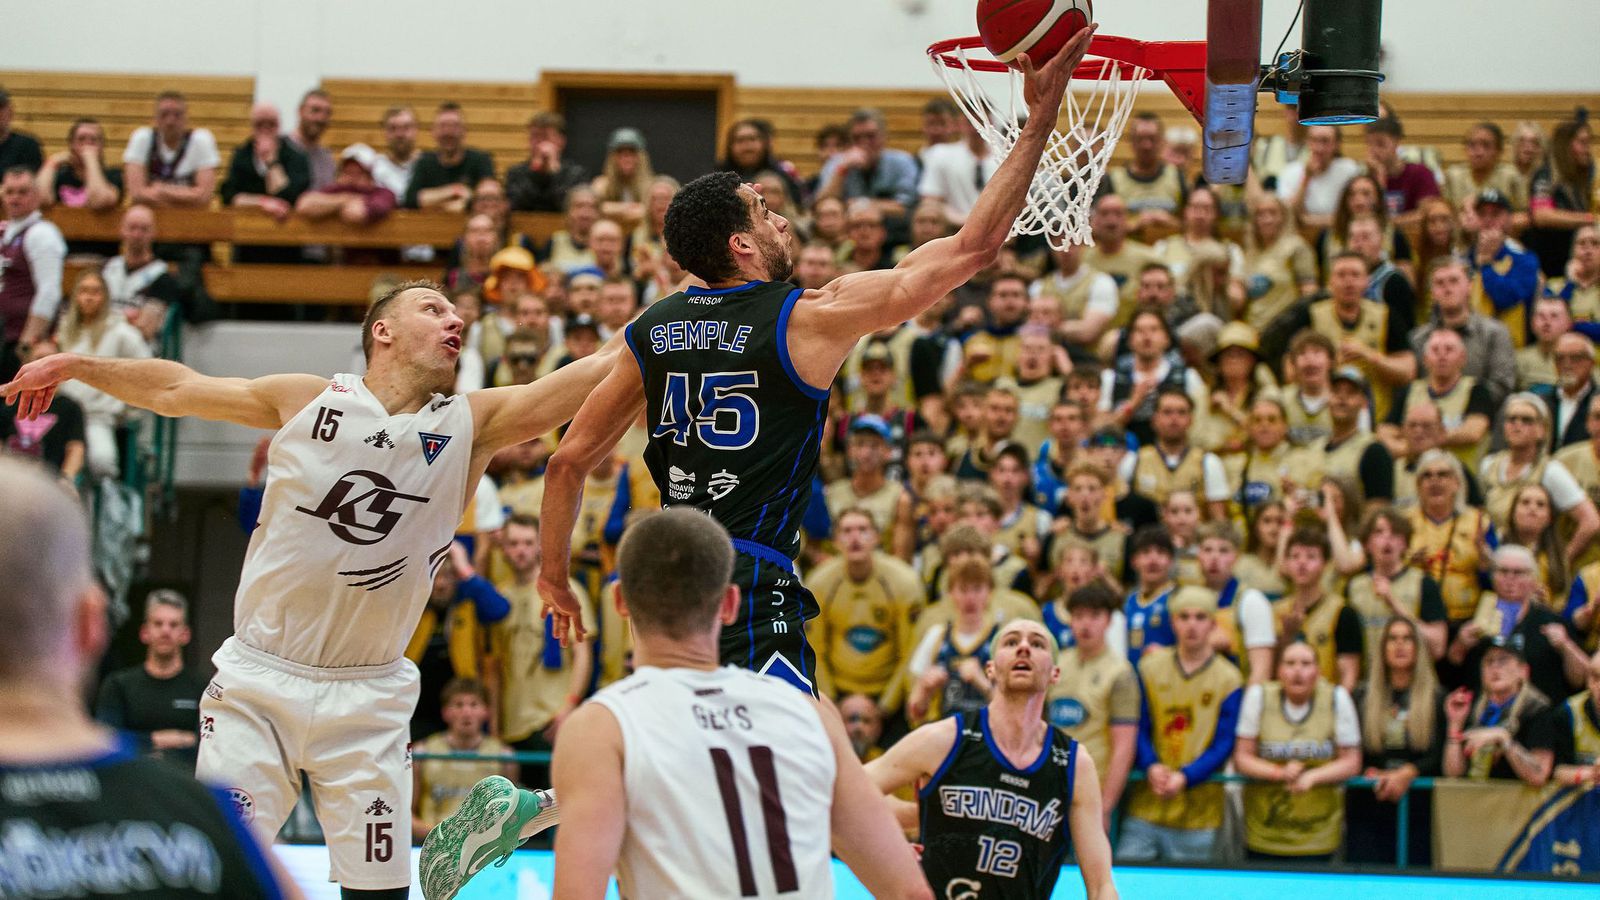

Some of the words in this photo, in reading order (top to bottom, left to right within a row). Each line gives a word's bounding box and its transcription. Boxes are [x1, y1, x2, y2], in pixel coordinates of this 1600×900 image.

[688, 296, 724, 306] HENSON
[650, 320, 753, 354] SEMPLE
[311, 406, 344, 442] 15
[653, 370, 759, 450] 45
[709, 745, 799, 897] 11
[365, 822, 393, 862] 15
[976, 835, 1022, 878] 12
